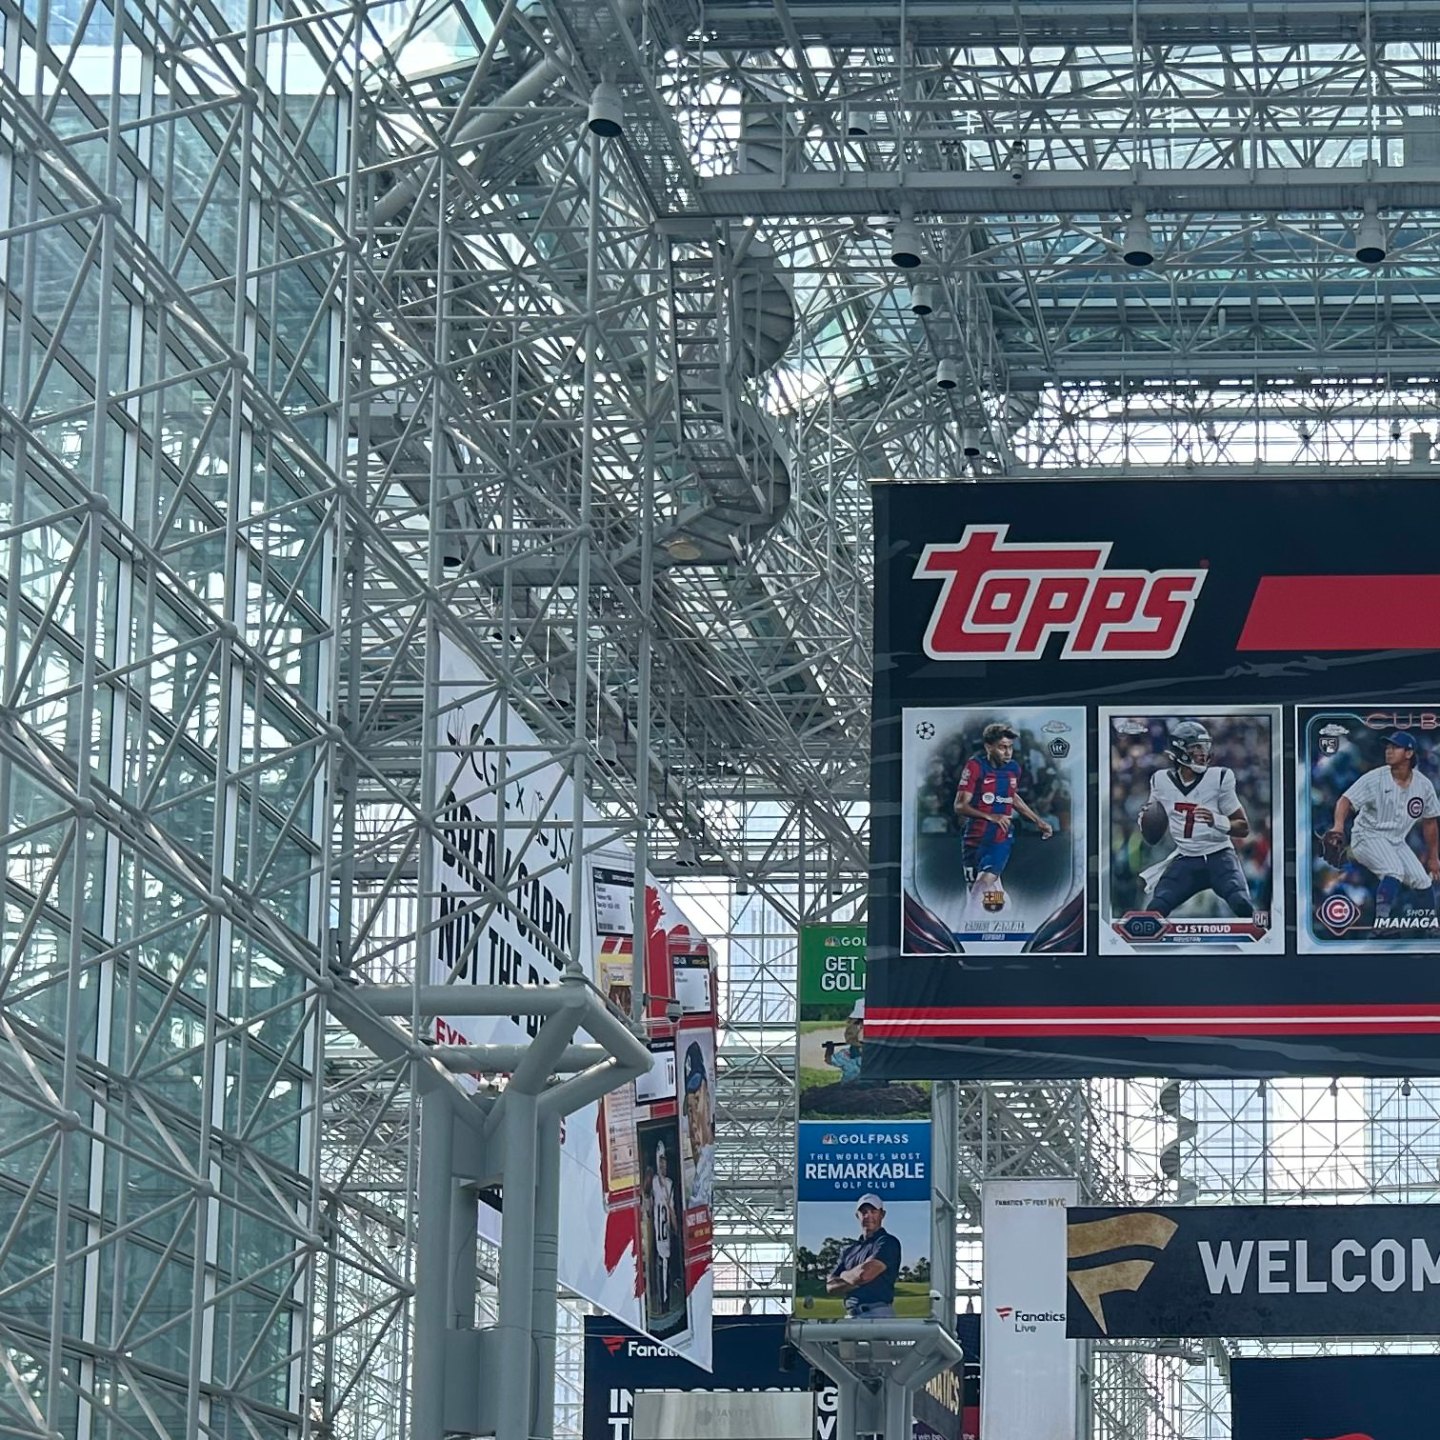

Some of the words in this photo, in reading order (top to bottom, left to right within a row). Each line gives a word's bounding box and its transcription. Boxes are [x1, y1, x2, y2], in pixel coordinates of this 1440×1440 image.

[1374, 917, 1439, 928] IMANAGA
[1176, 924, 1188, 933] CJ
[1190, 924, 1231, 933] STROUD
[825, 956, 858, 971] GET
[839, 1134, 909, 1144] GOLFPASS
[836, 1152, 886, 1160] WORLD'S
[891, 1152, 921, 1160] MOST
[805, 1163, 925, 1179] REMARKABLE
[834, 1181, 862, 1189] GOLF
[867, 1181, 895, 1189] CLUB
[1014, 1310, 1066, 1322] Fanatics
[1014, 1324, 1036, 1333] Live
